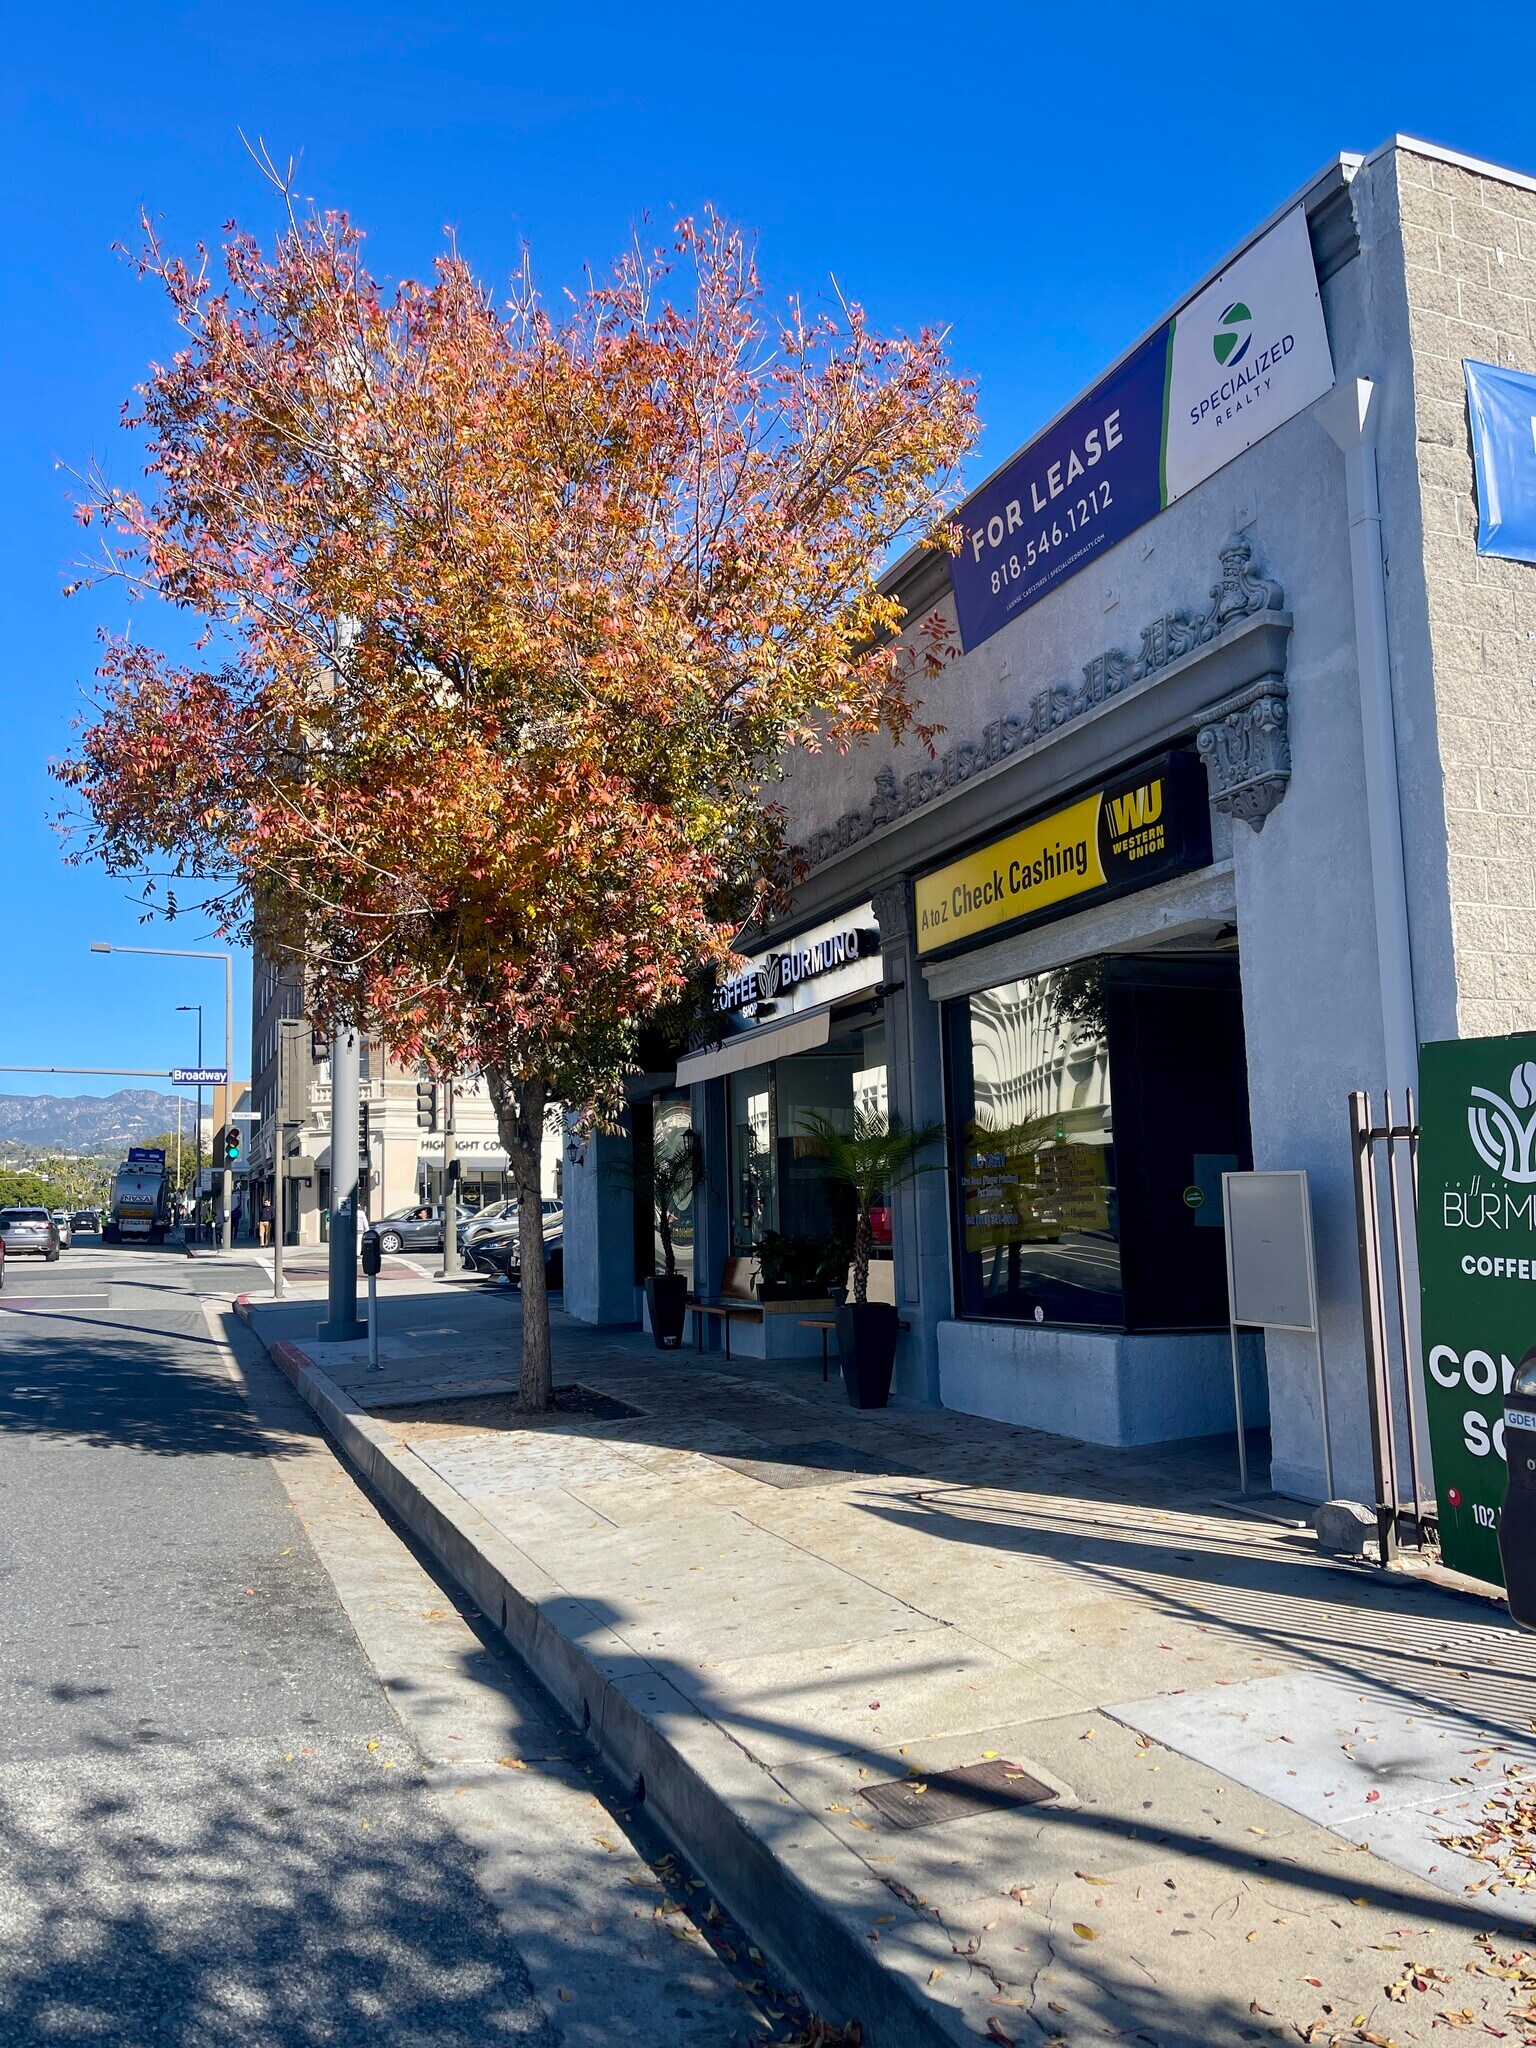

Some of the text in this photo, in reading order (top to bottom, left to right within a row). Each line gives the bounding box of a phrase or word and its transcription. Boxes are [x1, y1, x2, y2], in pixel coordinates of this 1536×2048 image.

[1190, 335, 1295, 426] SPECIALIZED
[1215, 377, 1271, 427] REALTY
[971, 408, 1124, 563] FOR LEASE
[991, 480, 1113, 594] 818.546.1212
[1105, 779, 1162, 838] WU
[1112, 824, 1164, 855] WESTERN
[1128, 837, 1165, 861] UNION
[921, 840, 1088, 931] A to Z Check Cashing
[781, 928, 860, 987] BURMUNQ
[742, 1002, 758, 1019] SHOP
[174, 1069, 227, 1083] Broadway
[421, 1140, 480, 1151] HIGIGHT
[1445, 1175, 1508, 1197] coffee
[1471, 1503, 1497, 1529] 102
